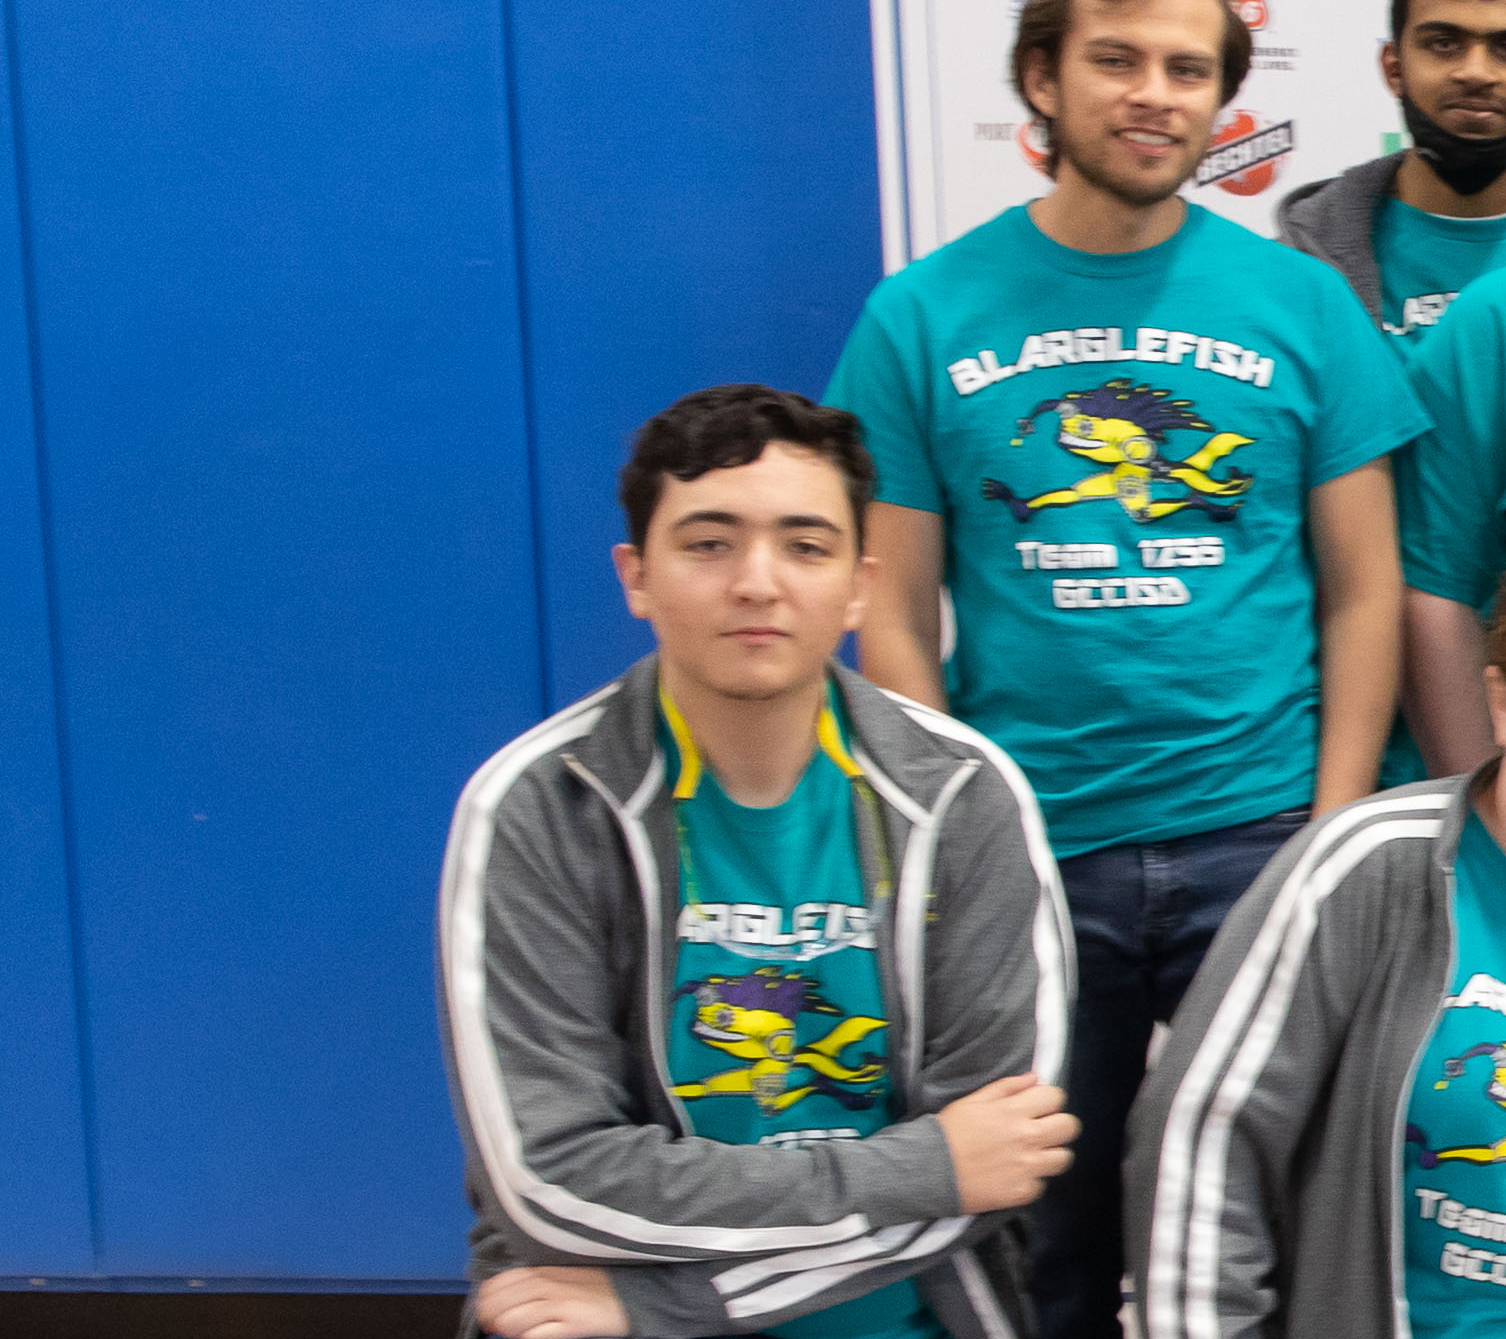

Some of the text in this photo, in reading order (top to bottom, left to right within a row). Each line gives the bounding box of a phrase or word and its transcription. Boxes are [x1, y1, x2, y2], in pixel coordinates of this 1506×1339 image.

[946, 326, 1275, 396] BLARGLEFISH
[1137, 536, 1226, 569] 1255
[1052, 576, 1192, 610] GCCISD
